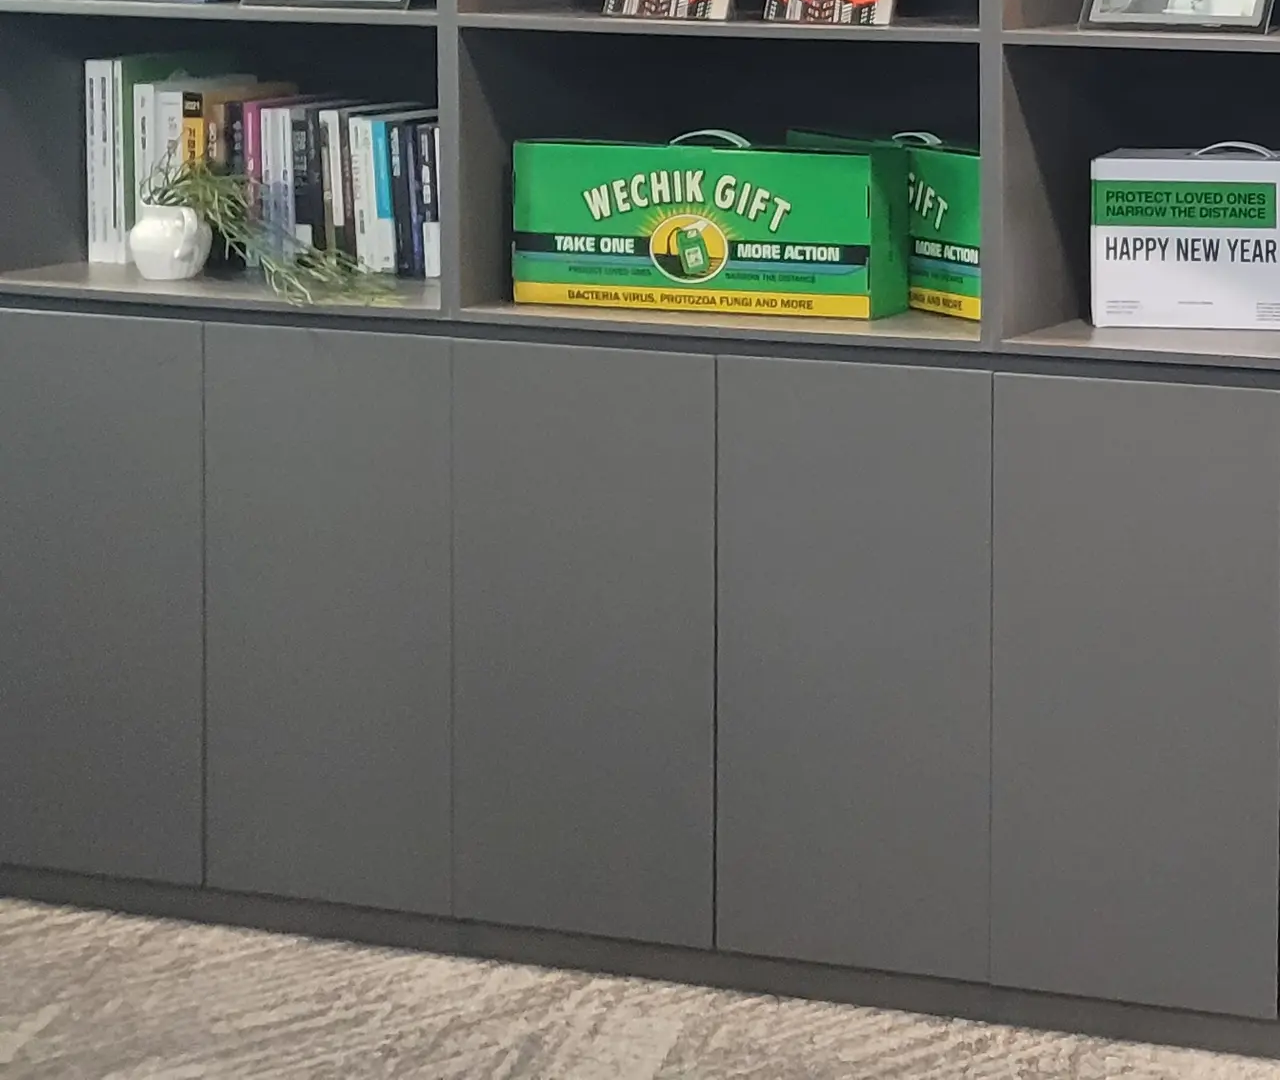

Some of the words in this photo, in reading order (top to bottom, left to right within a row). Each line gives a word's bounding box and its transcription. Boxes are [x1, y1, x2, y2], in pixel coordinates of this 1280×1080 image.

[583, 168, 706, 222] WECHIK
[713, 174, 792, 232] GIFT
[1105, 190, 1173, 204] PROTECT
[1175, 191, 1224, 205] LOVED
[1226, 192, 1267, 206] ONES
[1105, 205, 1168, 217] NARROW
[1169, 206, 1196, 218] THE
[1199, 207, 1267, 219] DISTANCE
[554, 235, 595, 253] TAKE
[600, 236, 635, 254] ONE
[737, 243, 780, 260] MORE
[784, 244, 841, 262] ACTION
[915, 240, 942, 258] MORE
[943, 245, 979, 264] ACTION
[1105, 235, 1170, 262] HAPPY
[1176, 236, 1221, 262] NEW
[1226, 237, 1278, 263] YEAR
[567, 289, 620, 301] BACTERIA
[622, 292, 658, 304] VIRUS,
[660, 294, 717, 306] PROTOZOA
[719, 296, 752, 308] FUNGI
[754, 298, 778, 308] AND
[780, 299, 814, 310] MORE
